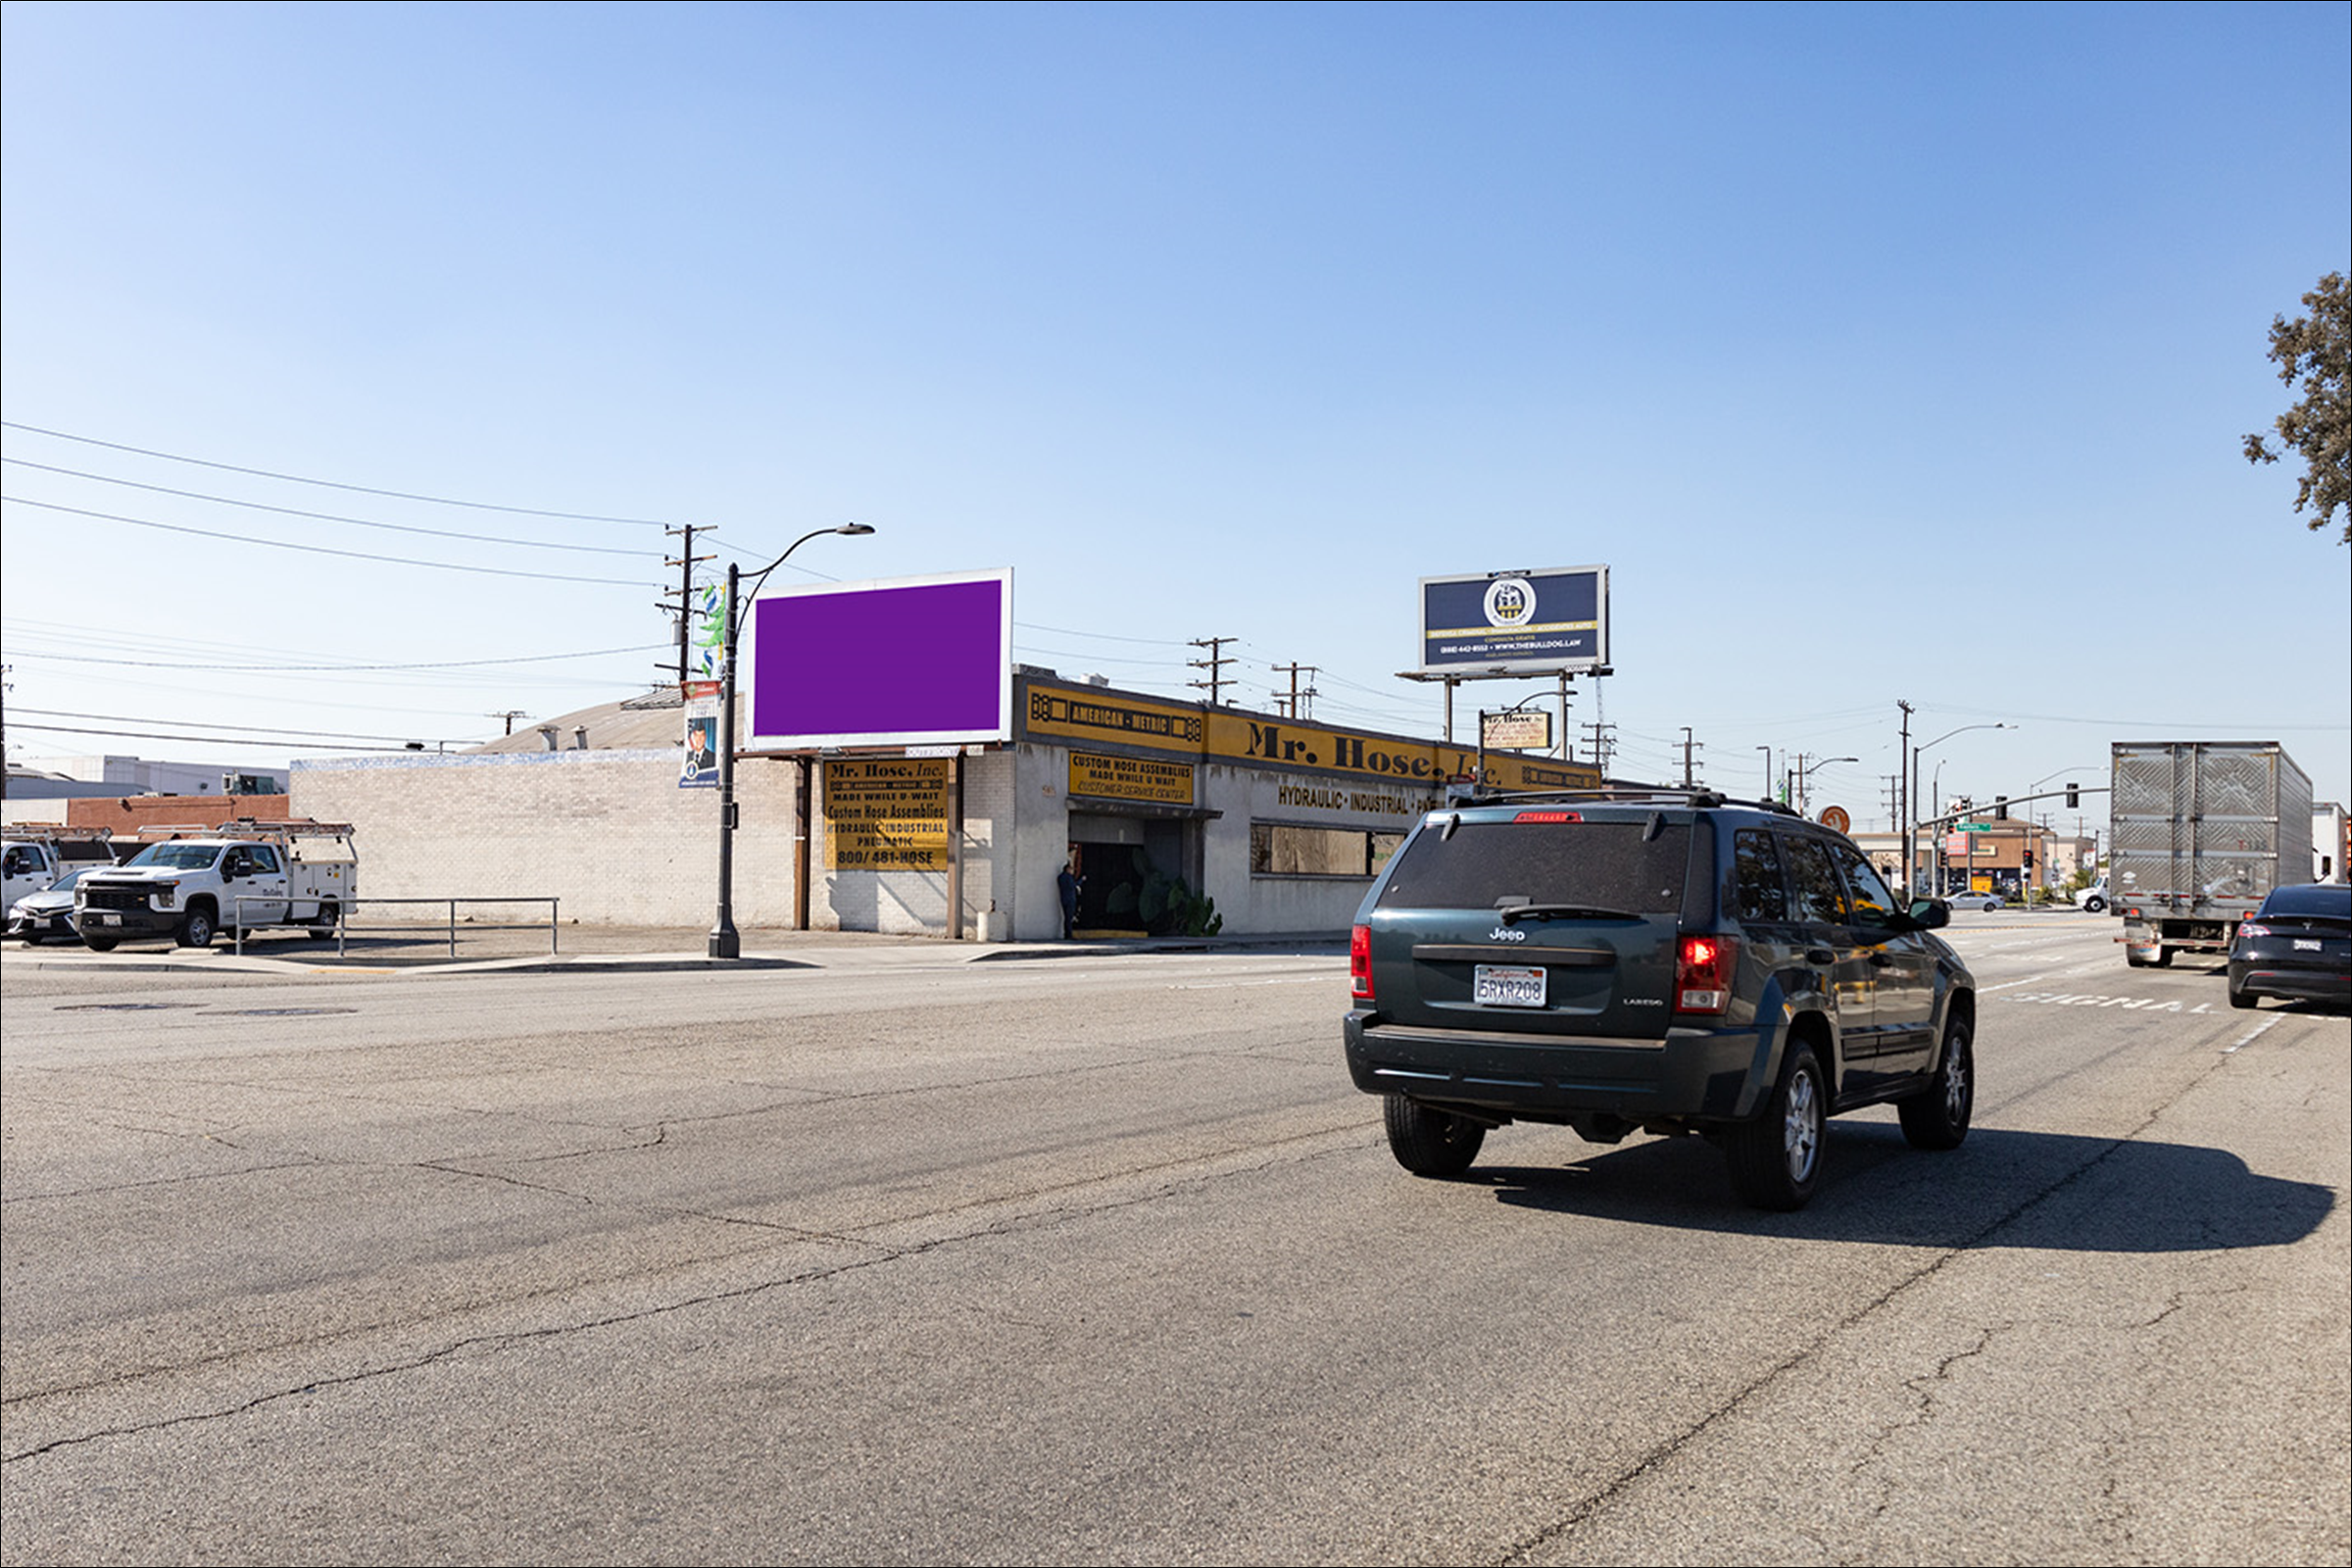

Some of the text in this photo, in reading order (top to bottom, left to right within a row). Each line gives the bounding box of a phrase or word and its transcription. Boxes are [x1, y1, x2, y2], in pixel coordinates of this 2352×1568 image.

[1072, 707, 1168, 733] AMERICAN METRIC
[1245, 722, 1318, 764] Mr.
[1456, 754, 1502, 786] Ic.
[831, 763, 858, 778] Mr.
[916, 763, 943, 777] Inc.
[1072, 756, 1191, 778] CUSTOM HOSE ASSEMBLIES
[1089, 769, 1176, 787] MADE WHILE U WAIT
[833, 793, 860, 802] MADE
[900, 792, 907, 801] U
[911, 792, 939, 801] WAIT
[1078, 780, 1187, 801] CUSTOMER SERVICE CENTER
[1278, 786, 1343, 809] HYDRAULIC
[1350, 792, 1409, 815] INDUSTRIAL
[828, 803, 945, 819] Custom Hose Assemblies
[885, 822, 945, 833] INDUSTRIAL
[1490, 927, 1526, 943] Jeep
[1480, 980, 1542, 1000] 5RXR208
[2000, 993, 2227, 1014] SIGNAL
